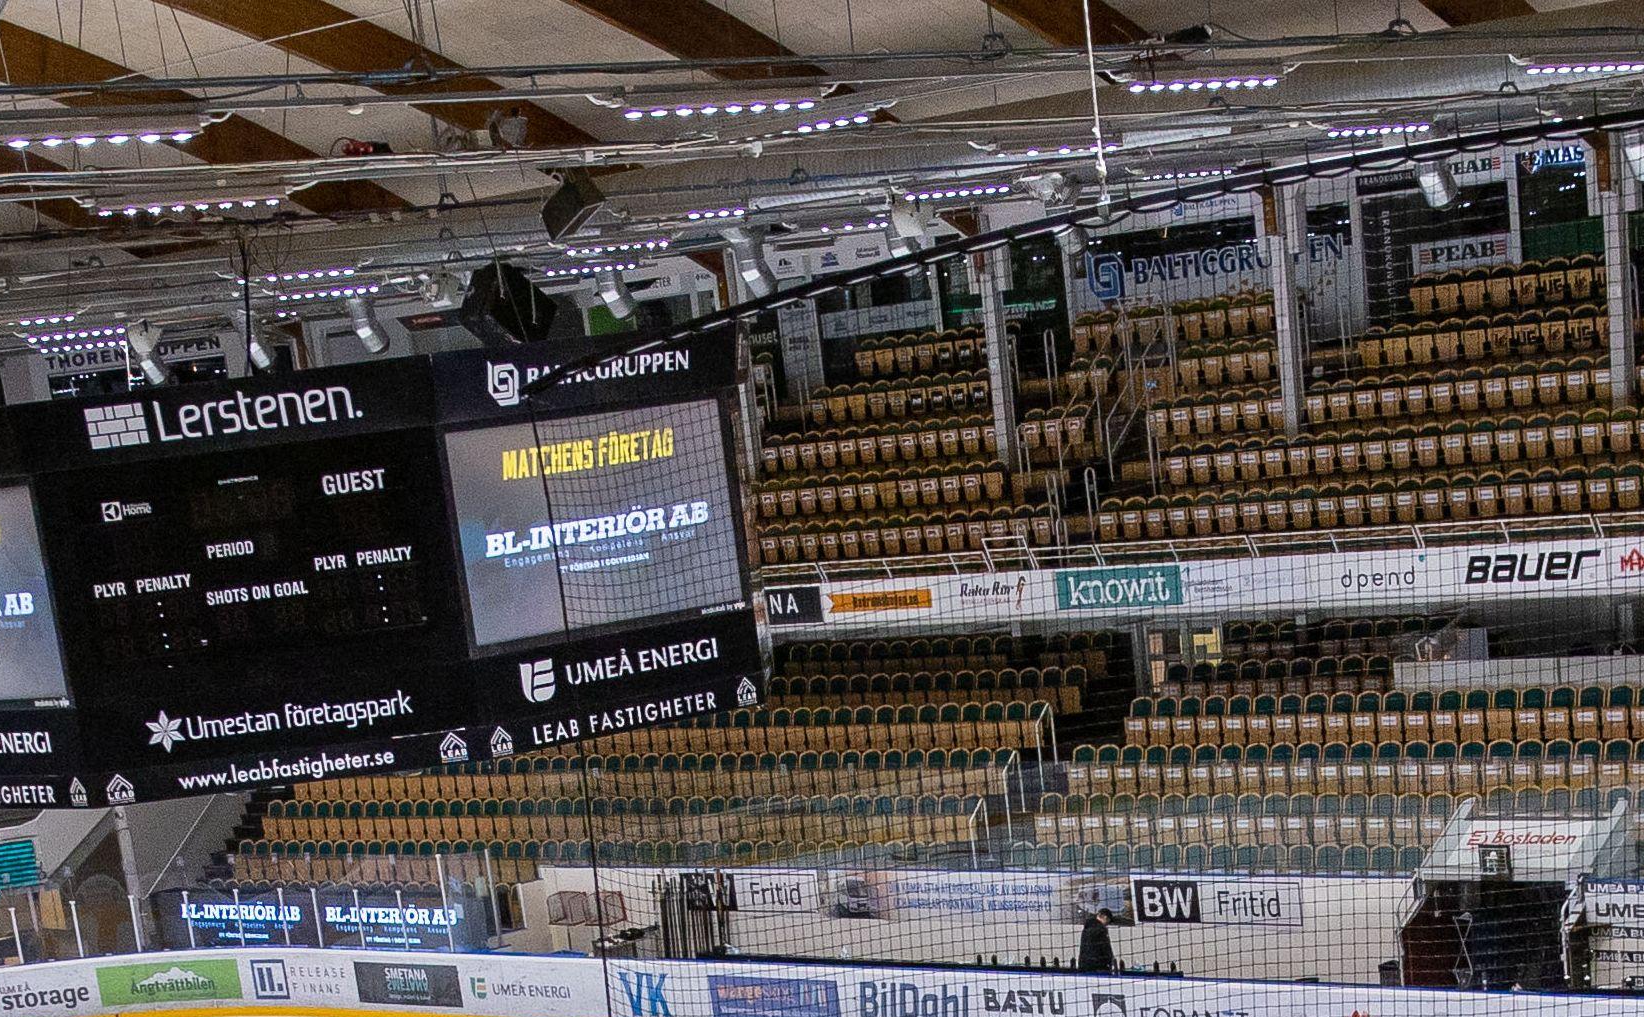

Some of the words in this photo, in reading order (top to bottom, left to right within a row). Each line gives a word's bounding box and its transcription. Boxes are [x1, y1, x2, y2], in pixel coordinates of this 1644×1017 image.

[1432, 241, 1497, 263] PEAB
[47, 334, 221, 372] THORENUPPEN
[154, 385, 363, 442] Lerstenen.
[502, 439, 594, 481] MATCHENS
[598, 427, 674, 466] FÖRETAG
[322, 469, 385, 496] GUEST
[669, 500, 709, 529] AB
[207, 540, 254, 559] PERIOD
[315, 552, 346, 571] PLYR
[357, 546, 412, 566] PENALTY
[94, 582, 127, 599] PLYR
[136, 573, 192, 595] PENALTY
[207, 589, 249, 606] SHOTS
[252, 585, 270, 601] ON
[274, 579, 309, 599] GOAL
[1067, 571, 1172, 608] knowit
[4, 592, 35, 616] AB
[565, 647, 635, 686] UMEÅ
[639, 636, 720, 671] ENERGI
[186, 709, 281, 741] Umestan
[285, 690, 413, 730] företagspark
[532, 719, 580, 745] LEAB
[590, 692, 717, 732] FASTIGHETER
[178, 747, 396, 791] www.leabfastigheter.se
[749, 881, 802, 909] Fritid
[1142, 885, 1193, 918] BW
[1216, 887, 1282, 920] Fritid
[289, 965, 349, 980] RELEASE
[384, 966, 428, 982] SMETANA
[0, 983, 91, 1012] storage
[130, 976, 217, 998] Ångtvättbilen
[290, 981, 343, 997] FINANS
[492, 979, 526, 997] UMEÅ
[527, 983, 572, 1000] ENERGI
[617, 971, 673, 1017] VK
[984, 987, 1066, 1017] BASTU
